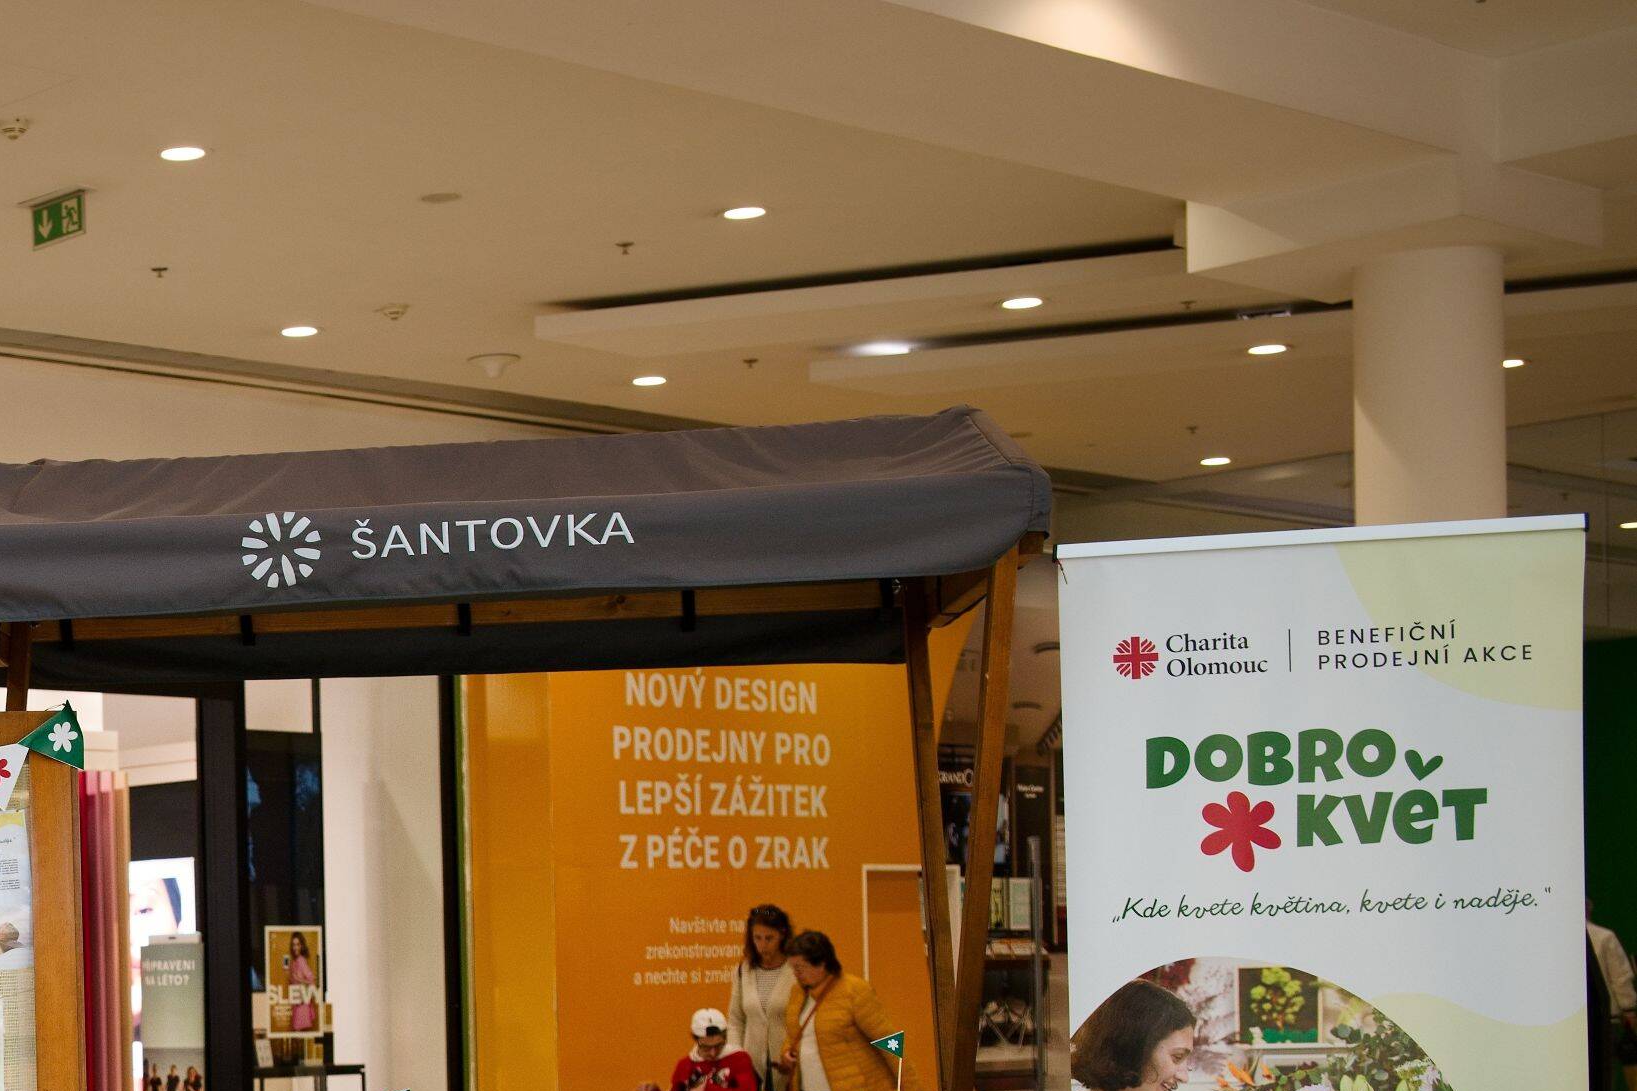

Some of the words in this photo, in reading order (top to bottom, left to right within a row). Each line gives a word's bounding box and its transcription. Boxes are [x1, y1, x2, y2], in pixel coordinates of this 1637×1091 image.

[351, 512, 635, 560] ŠANTOVKA
[1165, 632, 1249, 654] Charita
[1318, 618, 1456, 646] BENEFIČNÍ
[1166, 656, 1268, 678] Olomouc
[1318, 644, 1450, 671] PRODEJNÍ
[1464, 644, 1533, 663] AKCE
[625, 668, 706, 710] NOVÝ
[714, 676, 818, 715] DESIGN
[613, 725, 767, 765] PRODEJNY
[774, 732, 832, 767] PRO
[1146, 728, 1397, 790] DOBRO
[619, 773, 703, 816] LEPŠÍ
[710, 775, 828, 817] ZÁŽITEK
[619, 834, 639, 870] Z
[646, 826, 721, 870] PÉČE
[728, 834, 748, 869] O
[755, 836, 830, 870] ZRAK
[1177, 894, 1244, 920] kvete
[1359, 888, 1429, 914] kvete
